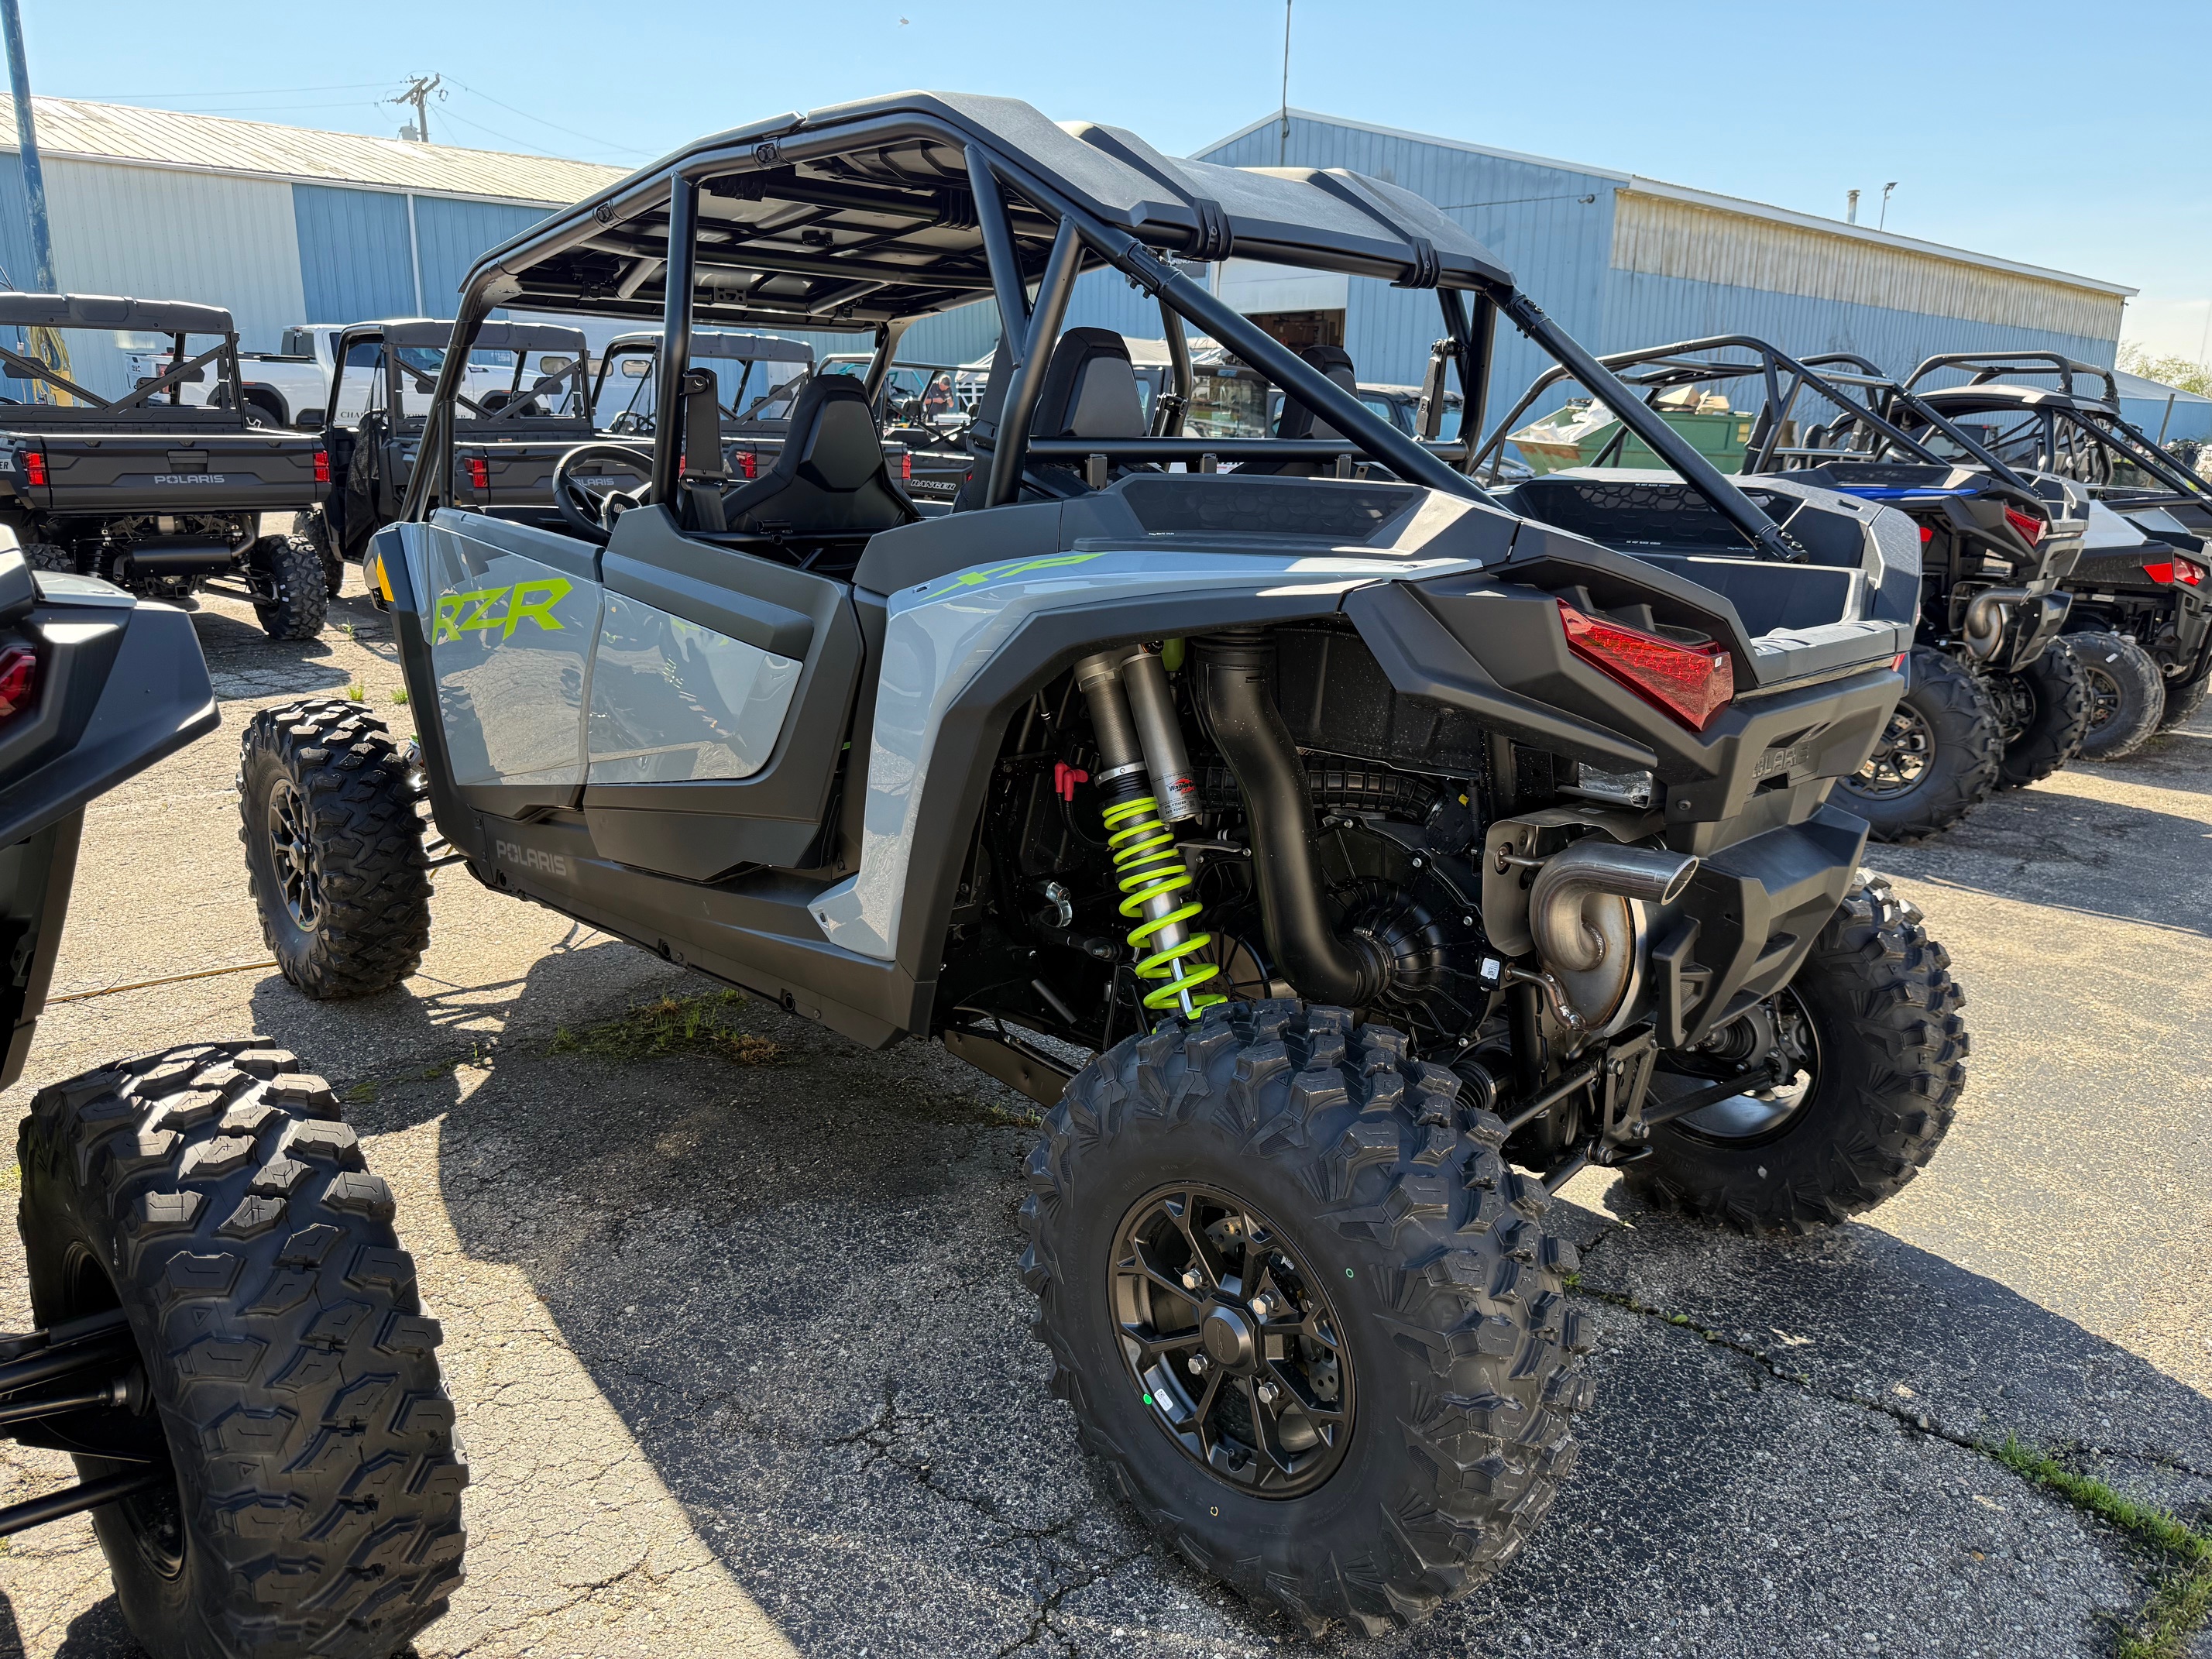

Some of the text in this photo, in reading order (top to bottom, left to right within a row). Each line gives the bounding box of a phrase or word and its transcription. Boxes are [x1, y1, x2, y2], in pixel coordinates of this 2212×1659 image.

[154, 475, 225, 484] POLARIS
[911, 479, 956, 490] RANGER
[431, 577, 574, 646] RZR
[496, 840, 567, 876] POLARIS
